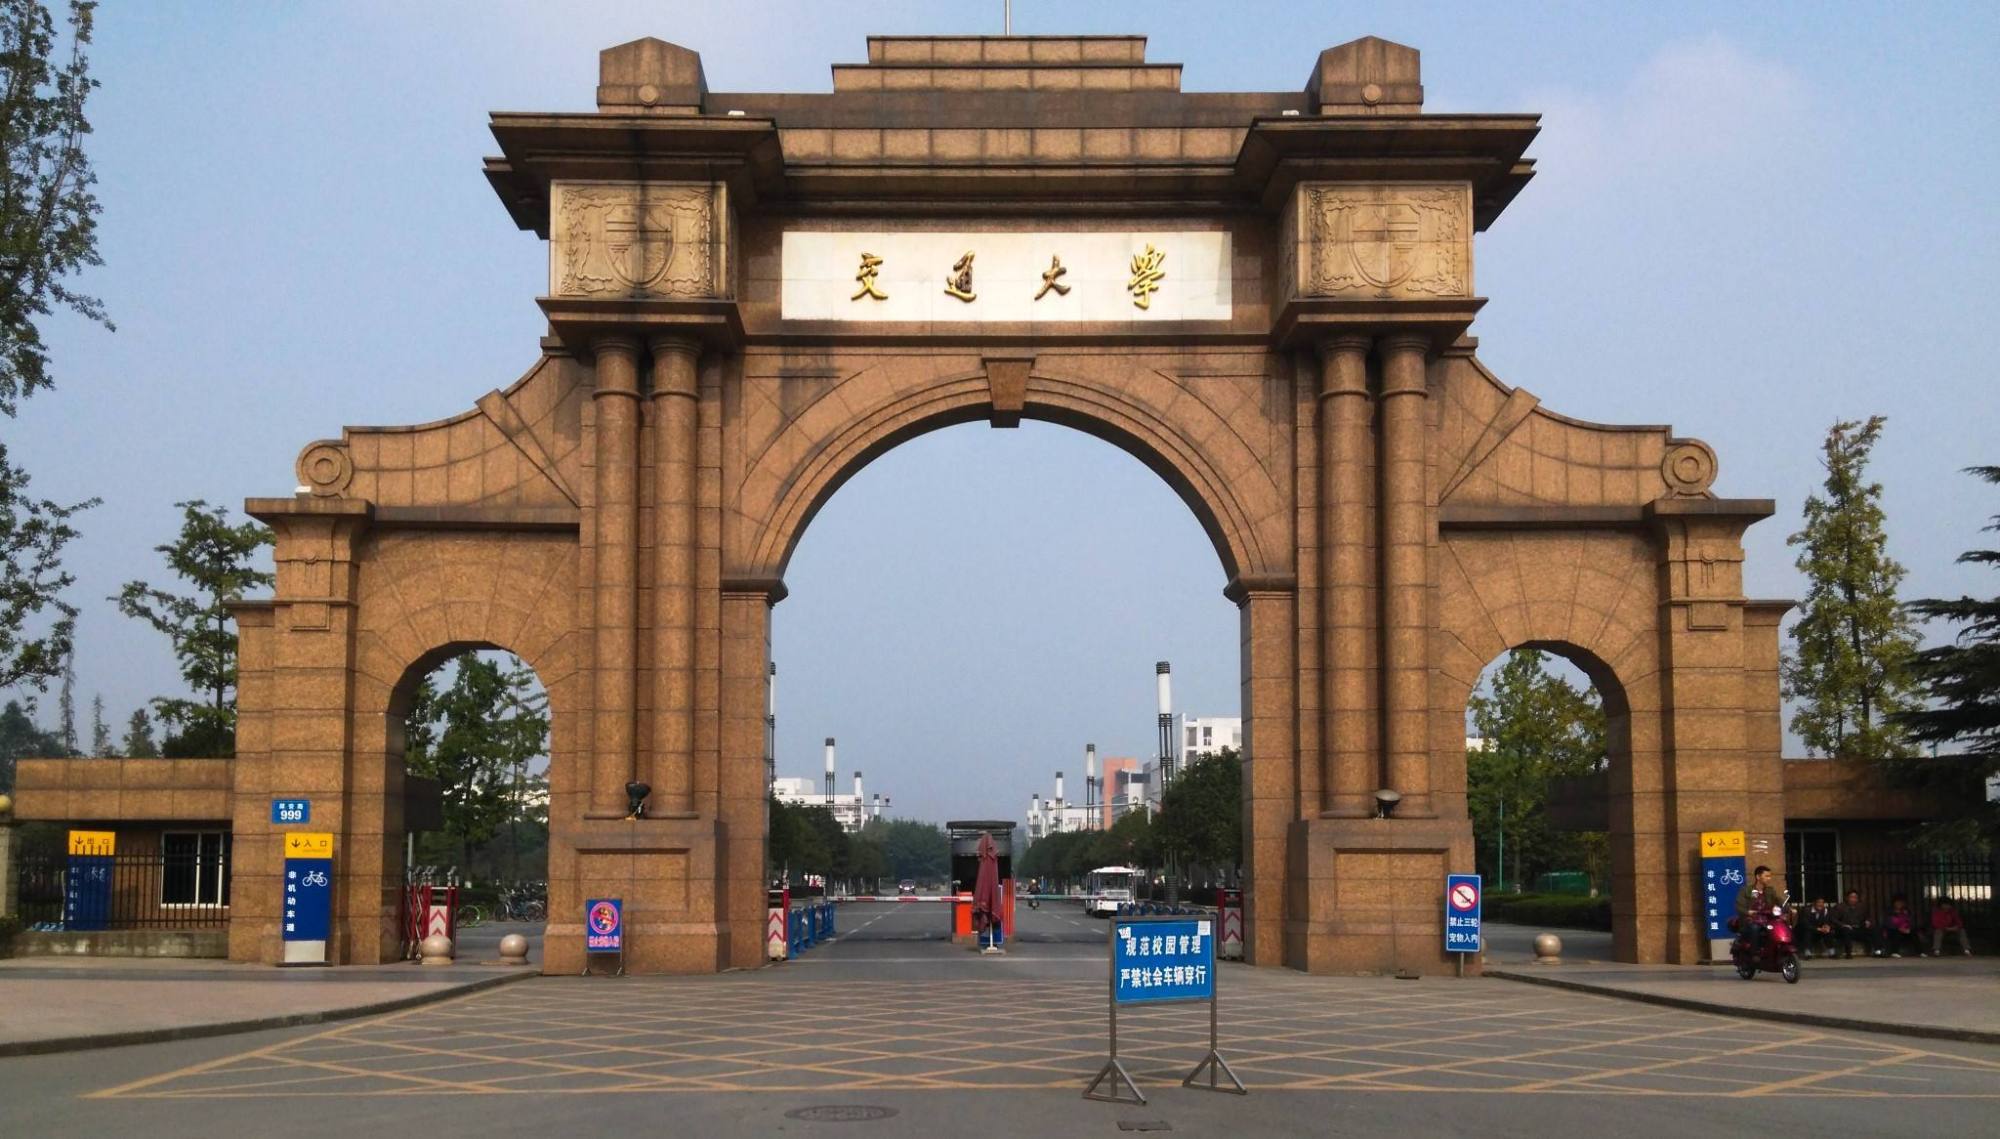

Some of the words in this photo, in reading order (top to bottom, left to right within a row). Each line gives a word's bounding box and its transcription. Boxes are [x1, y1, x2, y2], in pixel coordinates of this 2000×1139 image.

[280, 810, 302, 820] 999
[303, 839, 327, 847] 入口
[1719, 838, 1740, 846] 入口
[286, 871, 297, 932] 非机动车道
[1707, 870, 1719, 930] 非机动车道
[1126, 935, 1201, 956] 规范校园管理
[1120, 965, 1206, 989] 严禁社会车辆穿行
